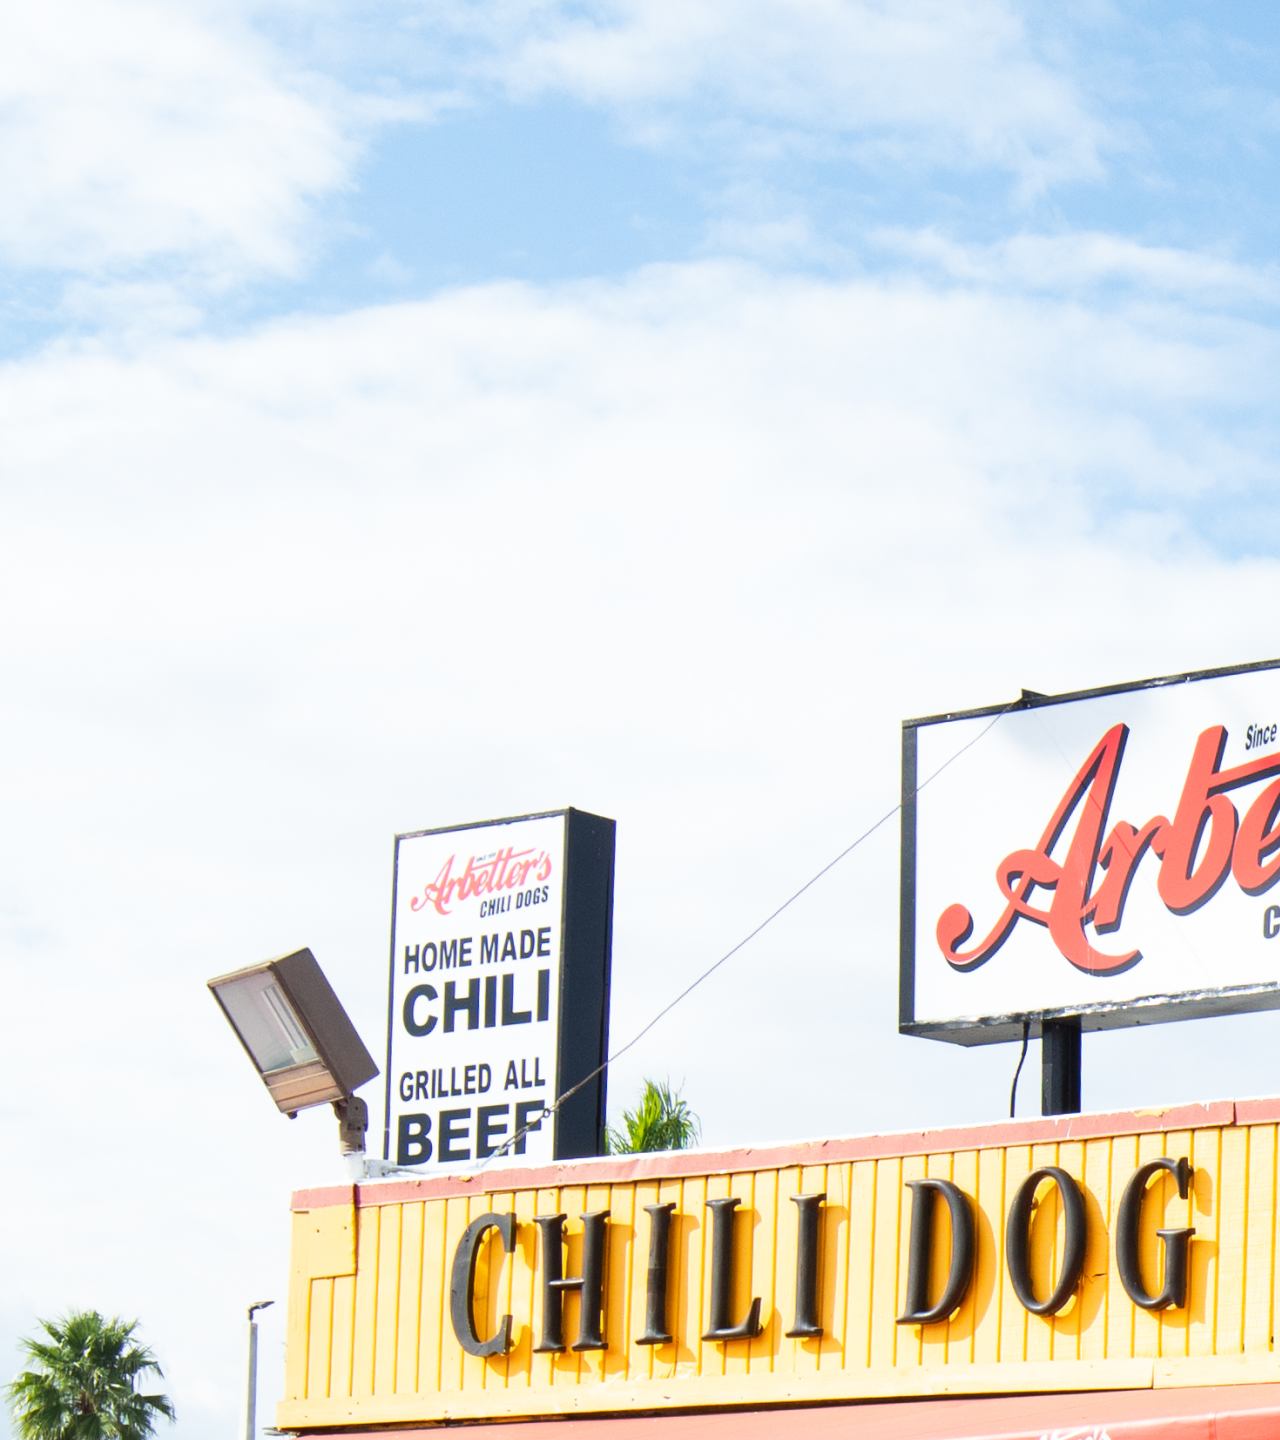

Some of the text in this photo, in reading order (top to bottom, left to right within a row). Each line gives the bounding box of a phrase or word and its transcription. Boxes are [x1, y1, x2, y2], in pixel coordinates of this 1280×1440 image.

[1244, 723, 1277, 751] Since
[411, 847, 552, 915] Arbetter's
[480, 886, 549, 918] CHILI DOGS
[404, 927, 551, 974] HOME MADE
[402, 969, 550, 1038] CHILI
[399, 1057, 546, 1102] GRILLED ALL
[397, 1100, 546, 1167] BEEF
[449, 1192, 828, 1359] CHILI
[896, 1156, 1196, 1327] DOG
